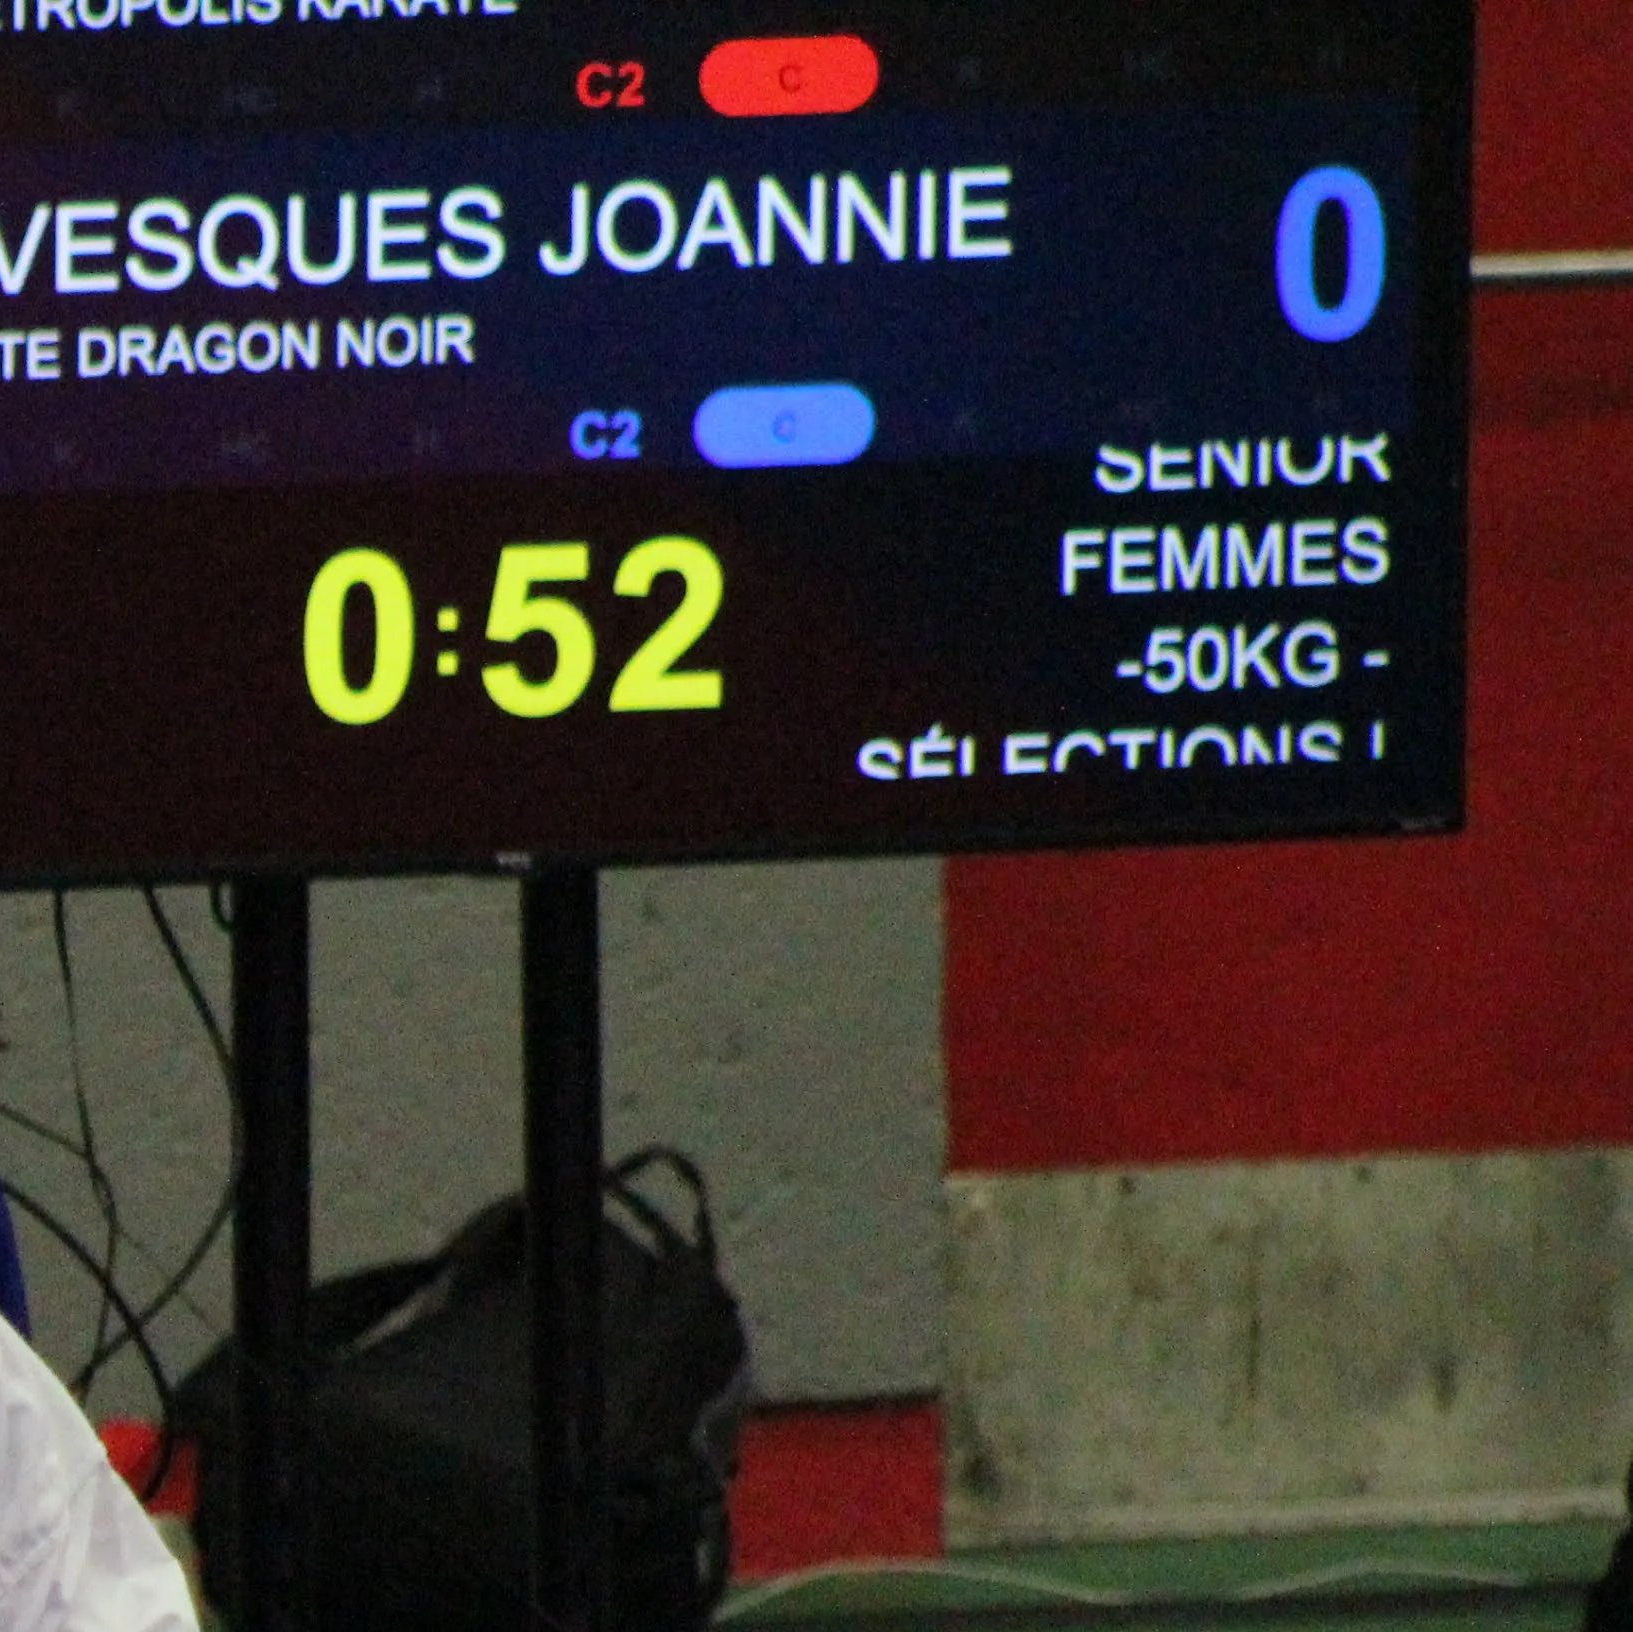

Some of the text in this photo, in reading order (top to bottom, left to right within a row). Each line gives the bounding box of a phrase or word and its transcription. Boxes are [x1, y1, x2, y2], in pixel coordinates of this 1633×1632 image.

[575, 61, 645, 109] C2
[537, 166, 1011, 277] JOANNIE
[1274, 165, 1386, 343] 0
[77, 322, 319, 379] DRAGON
[335, 315, 473, 369] NOIR
[568, 410, 641, 460] C2
[1059, 517, 1390, 596] FEMMES
[303, 535, 723, 725] 0:52
[1115, 621, 1340, 694] -50KG
